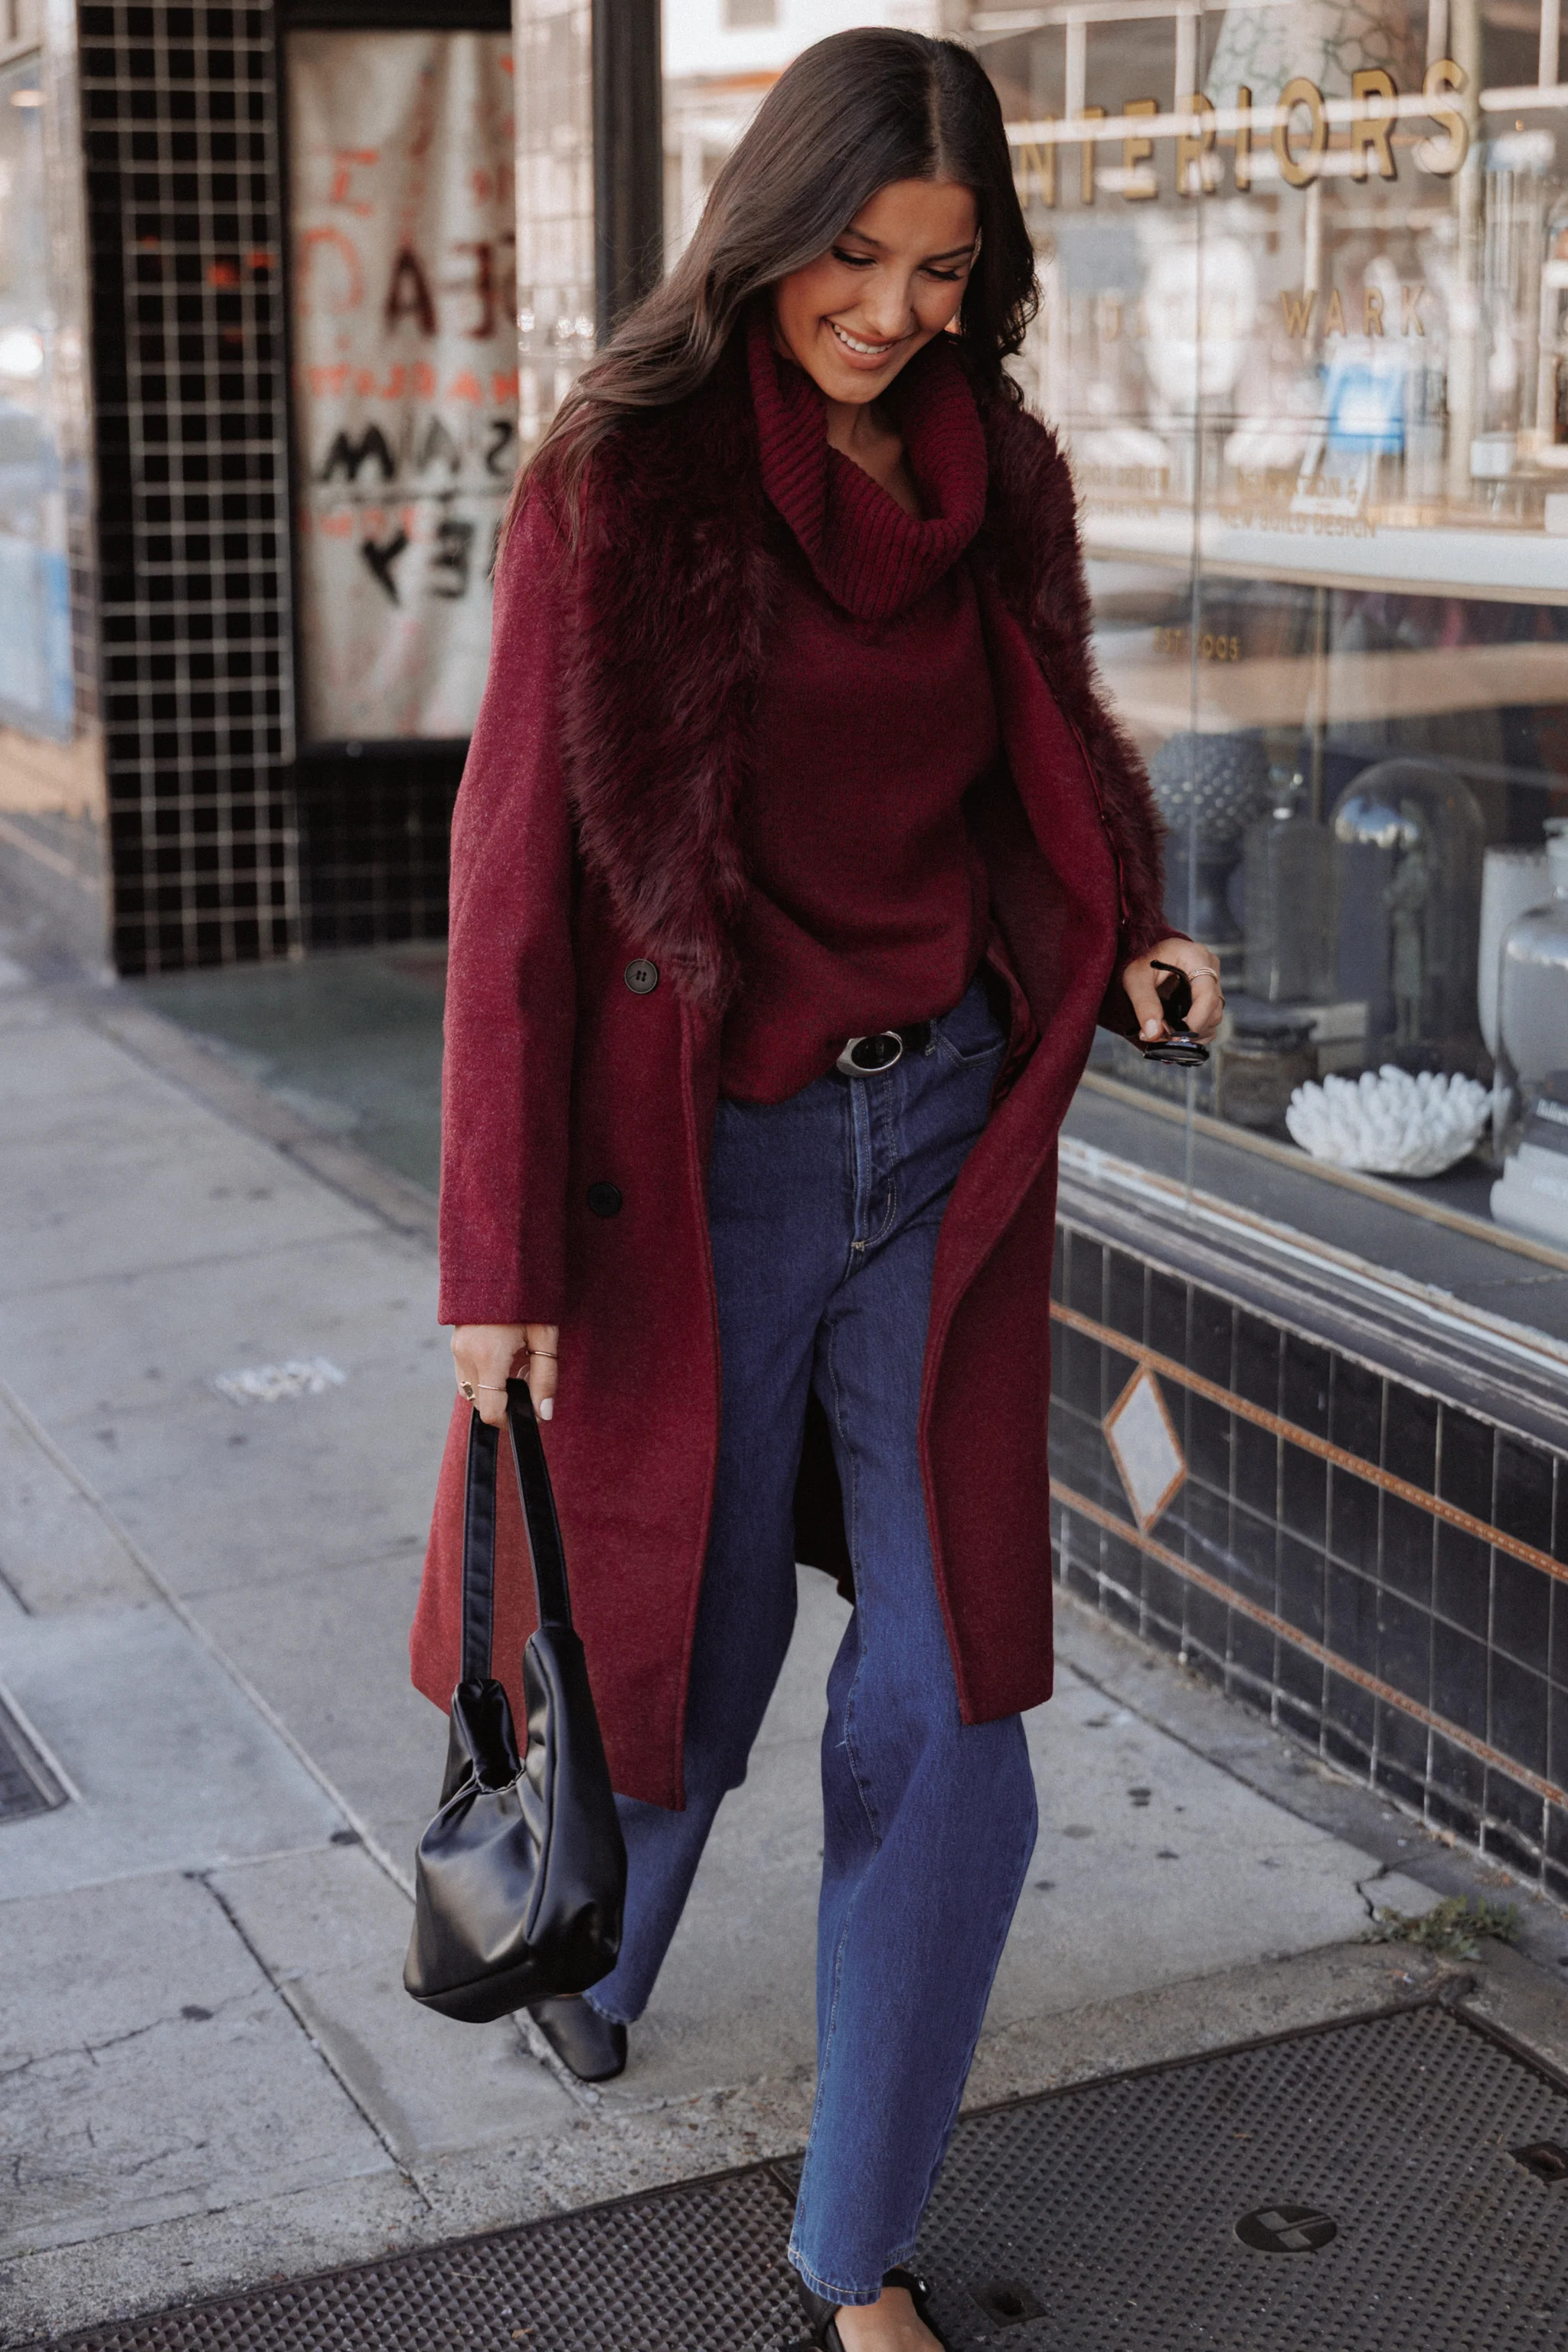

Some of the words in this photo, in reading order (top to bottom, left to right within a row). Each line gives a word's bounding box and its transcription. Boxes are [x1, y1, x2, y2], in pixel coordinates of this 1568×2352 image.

[1017, 58, 1469, 207] NTERIORS
[1280, 285, 1425, 338] WARK
[1199, 632, 1240, 662] 005
